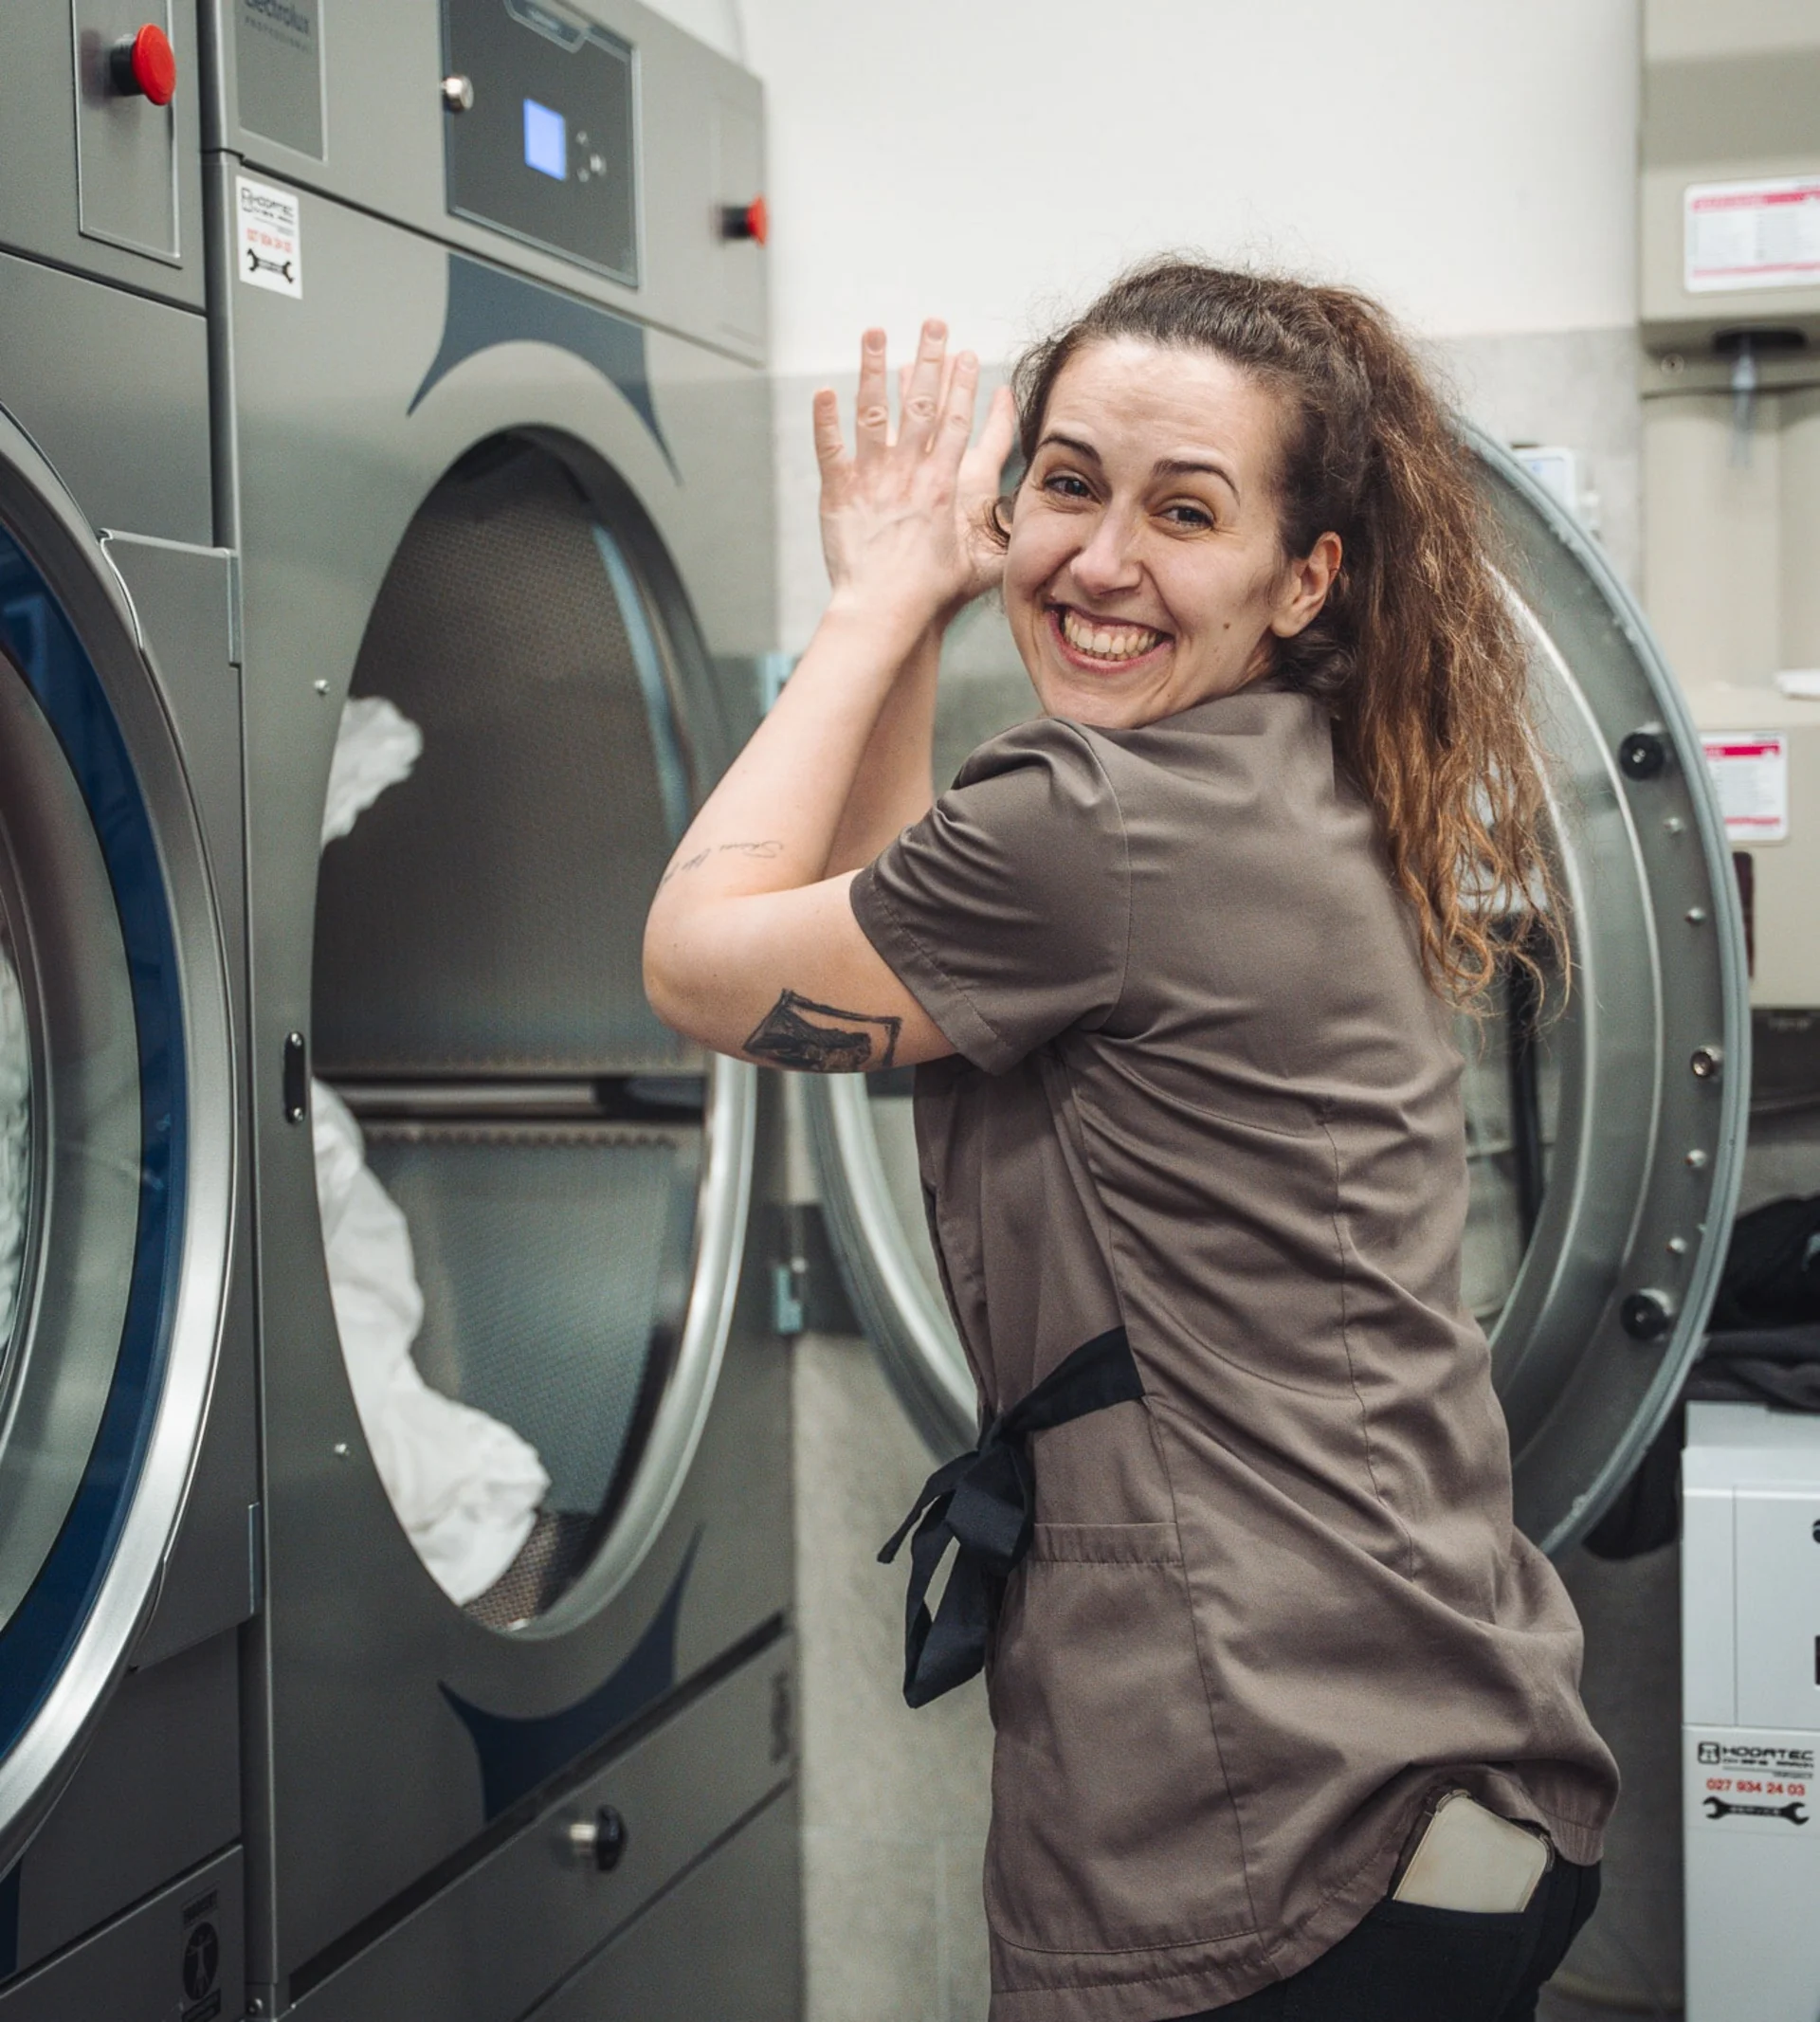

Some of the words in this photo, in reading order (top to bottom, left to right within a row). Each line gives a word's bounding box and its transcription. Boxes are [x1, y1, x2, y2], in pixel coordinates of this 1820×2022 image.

[1706, 1778, 1731, 1791] 027
[1737, 1780, 1761, 1793] 934
[1766, 1782, 1783, 1794] 24
